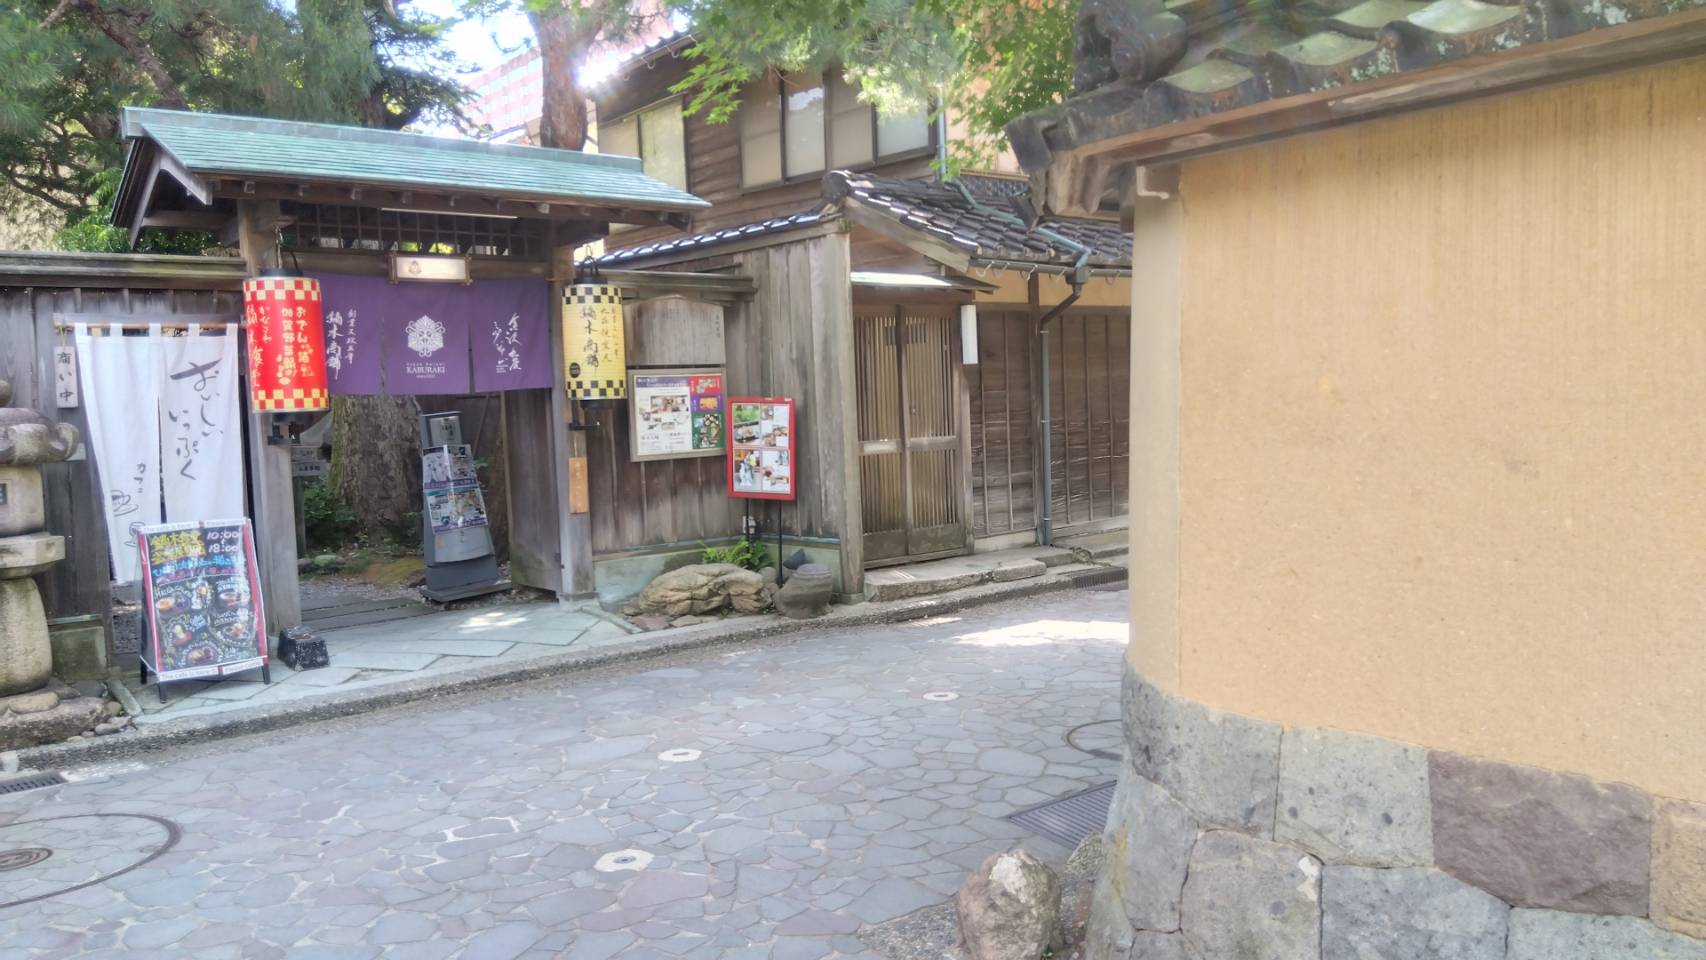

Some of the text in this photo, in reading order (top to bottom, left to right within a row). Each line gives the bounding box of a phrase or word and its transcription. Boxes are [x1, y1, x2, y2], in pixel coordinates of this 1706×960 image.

[56, 351, 74, 402] 商い中
[406, 366, 446, 374] KABURAKI
[169, 358, 224, 438] おいしい
[168, 409, 199, 481] いっぷく
[207, 530, 240, 540] 10:00
[208, 543, 240, 553] 18:00
